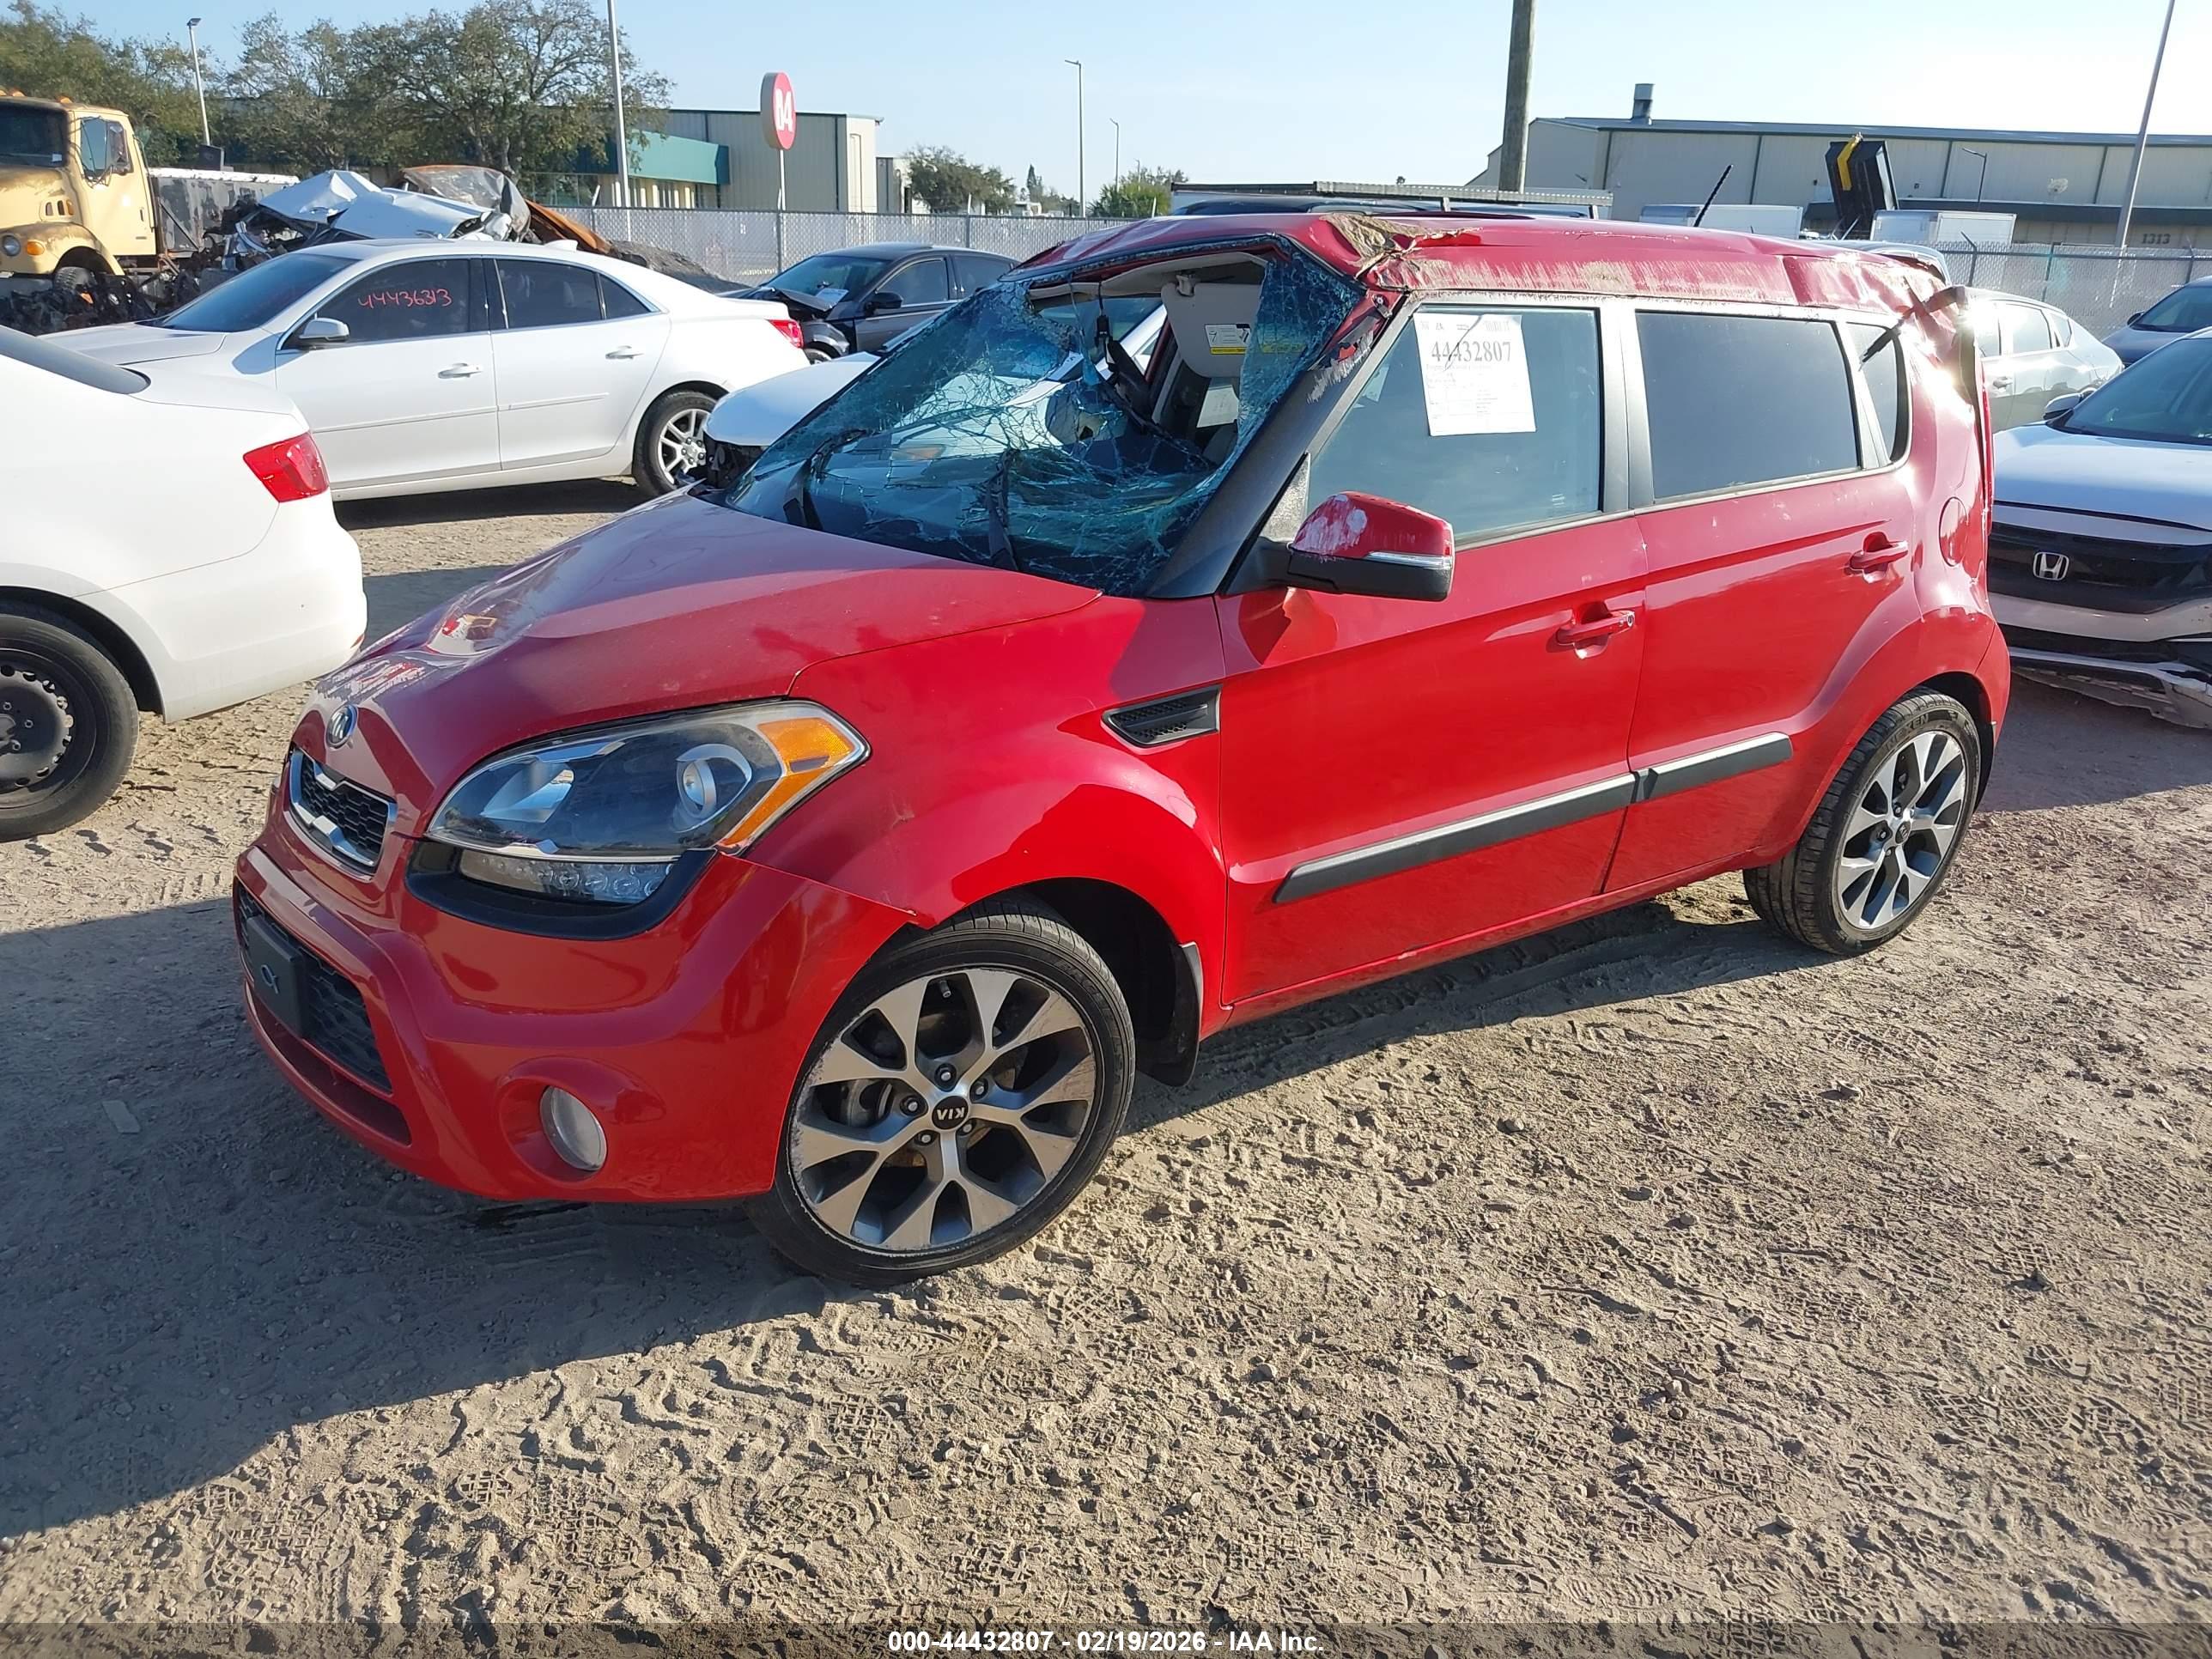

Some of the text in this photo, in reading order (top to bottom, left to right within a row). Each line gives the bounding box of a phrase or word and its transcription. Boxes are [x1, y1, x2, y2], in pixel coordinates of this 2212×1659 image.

[2142, 233, 2171, 245] 1313
[357, 289, 452, 308] 44436313
[1431, 341, 1511, 362] 44432807
[936, 1107, 965, 1121] KIA
